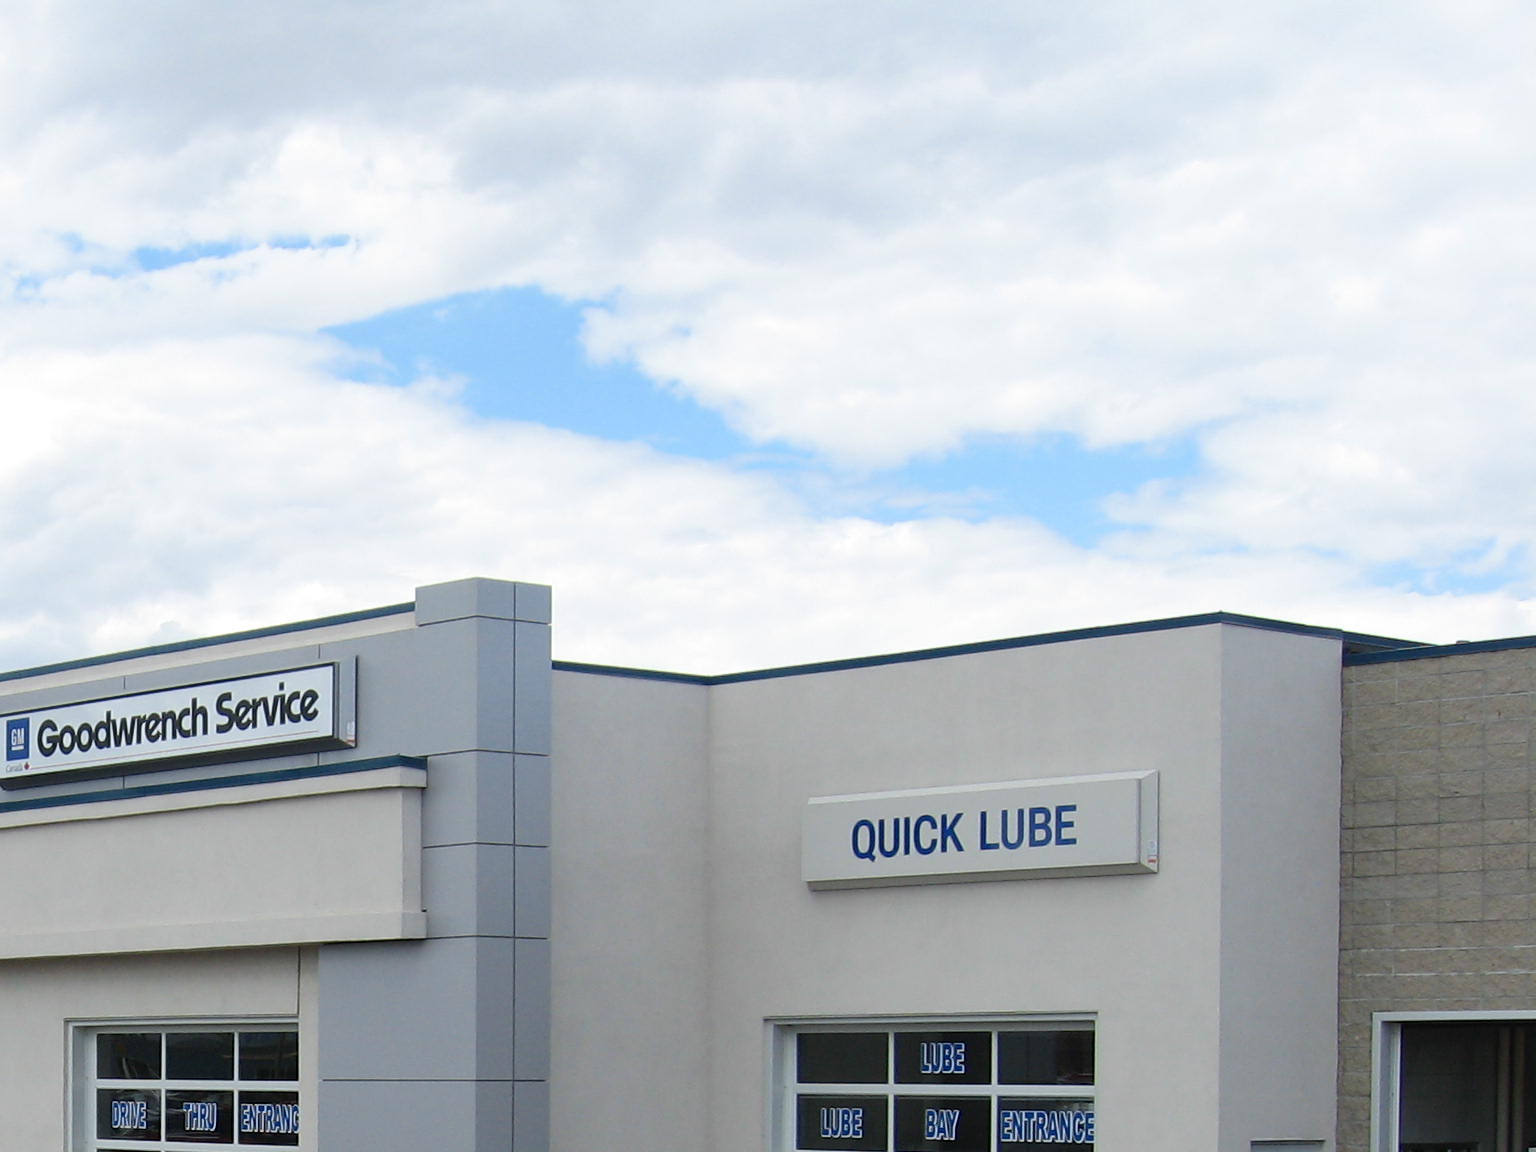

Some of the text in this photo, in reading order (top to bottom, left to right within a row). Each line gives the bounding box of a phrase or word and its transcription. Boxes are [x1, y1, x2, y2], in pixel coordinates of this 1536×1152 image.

[37, 682, 319, 757] Goodwrench Service
[851, 804, 1077, 862] QUICK LUBE
[920, 1042, 965, 1074] LUBE
[112, 1100, 147, 1129] DRIVE
[182, 1102, 218, 1131] THRU
[820, 1107, 1095, 1143] LUBE BAY ENTRANCE
